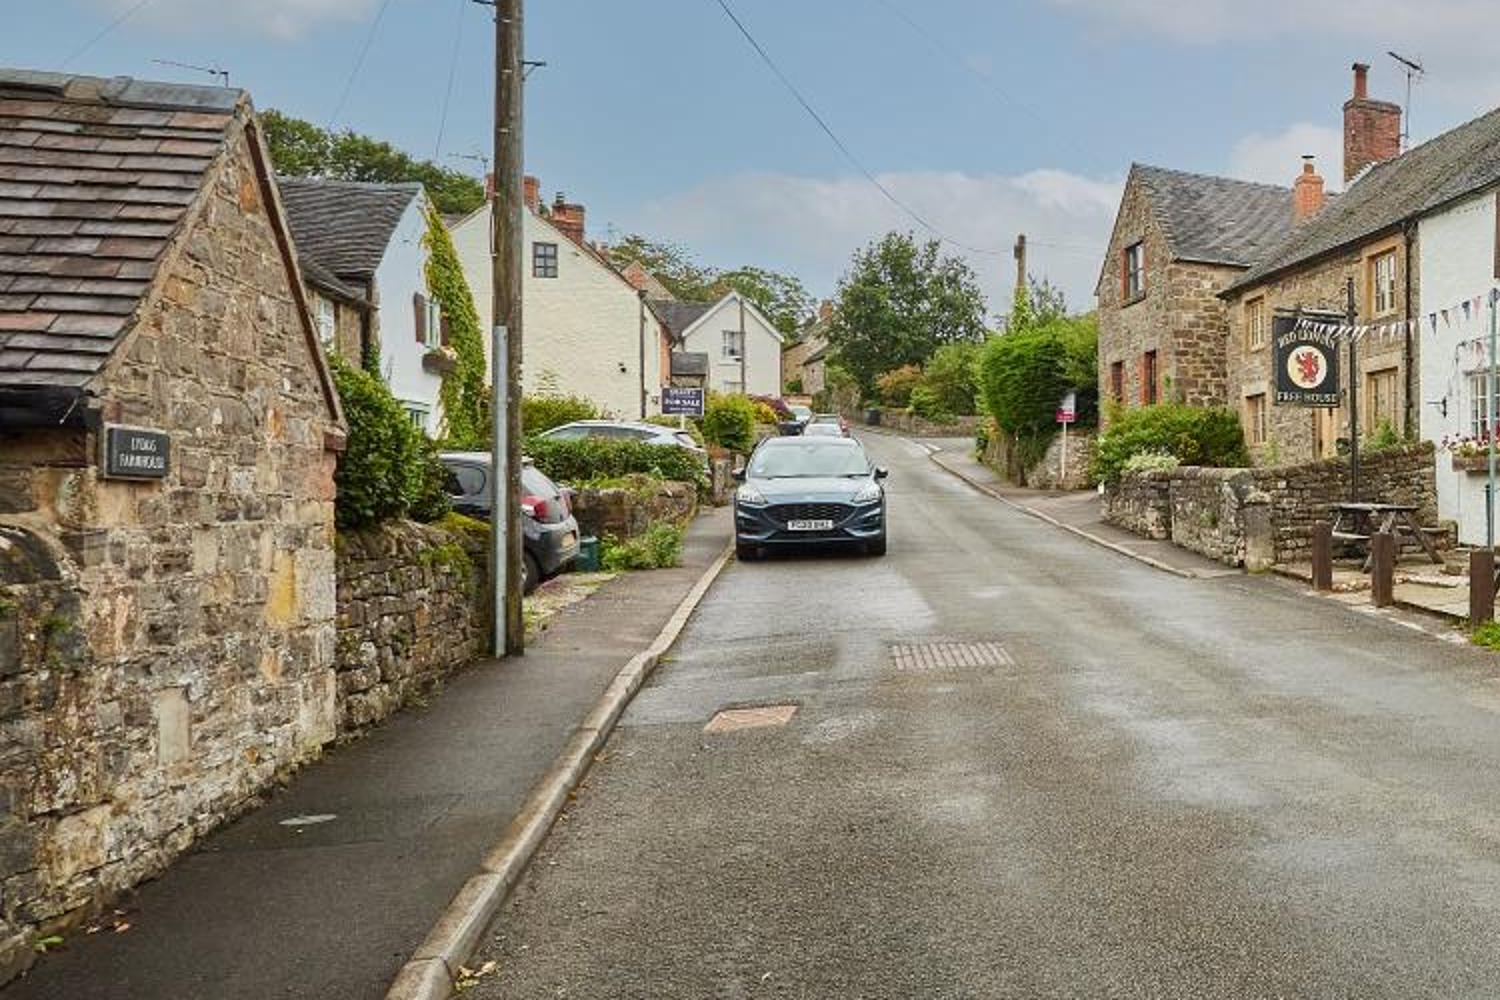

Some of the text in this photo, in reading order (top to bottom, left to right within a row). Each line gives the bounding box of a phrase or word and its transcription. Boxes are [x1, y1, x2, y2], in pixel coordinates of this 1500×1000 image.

[664, 397, 701, 407] FOR SALE
[1277, 391, 1337, 403] FREE HOUSE
[119, 453, 165, 469] FARMHOUSE
